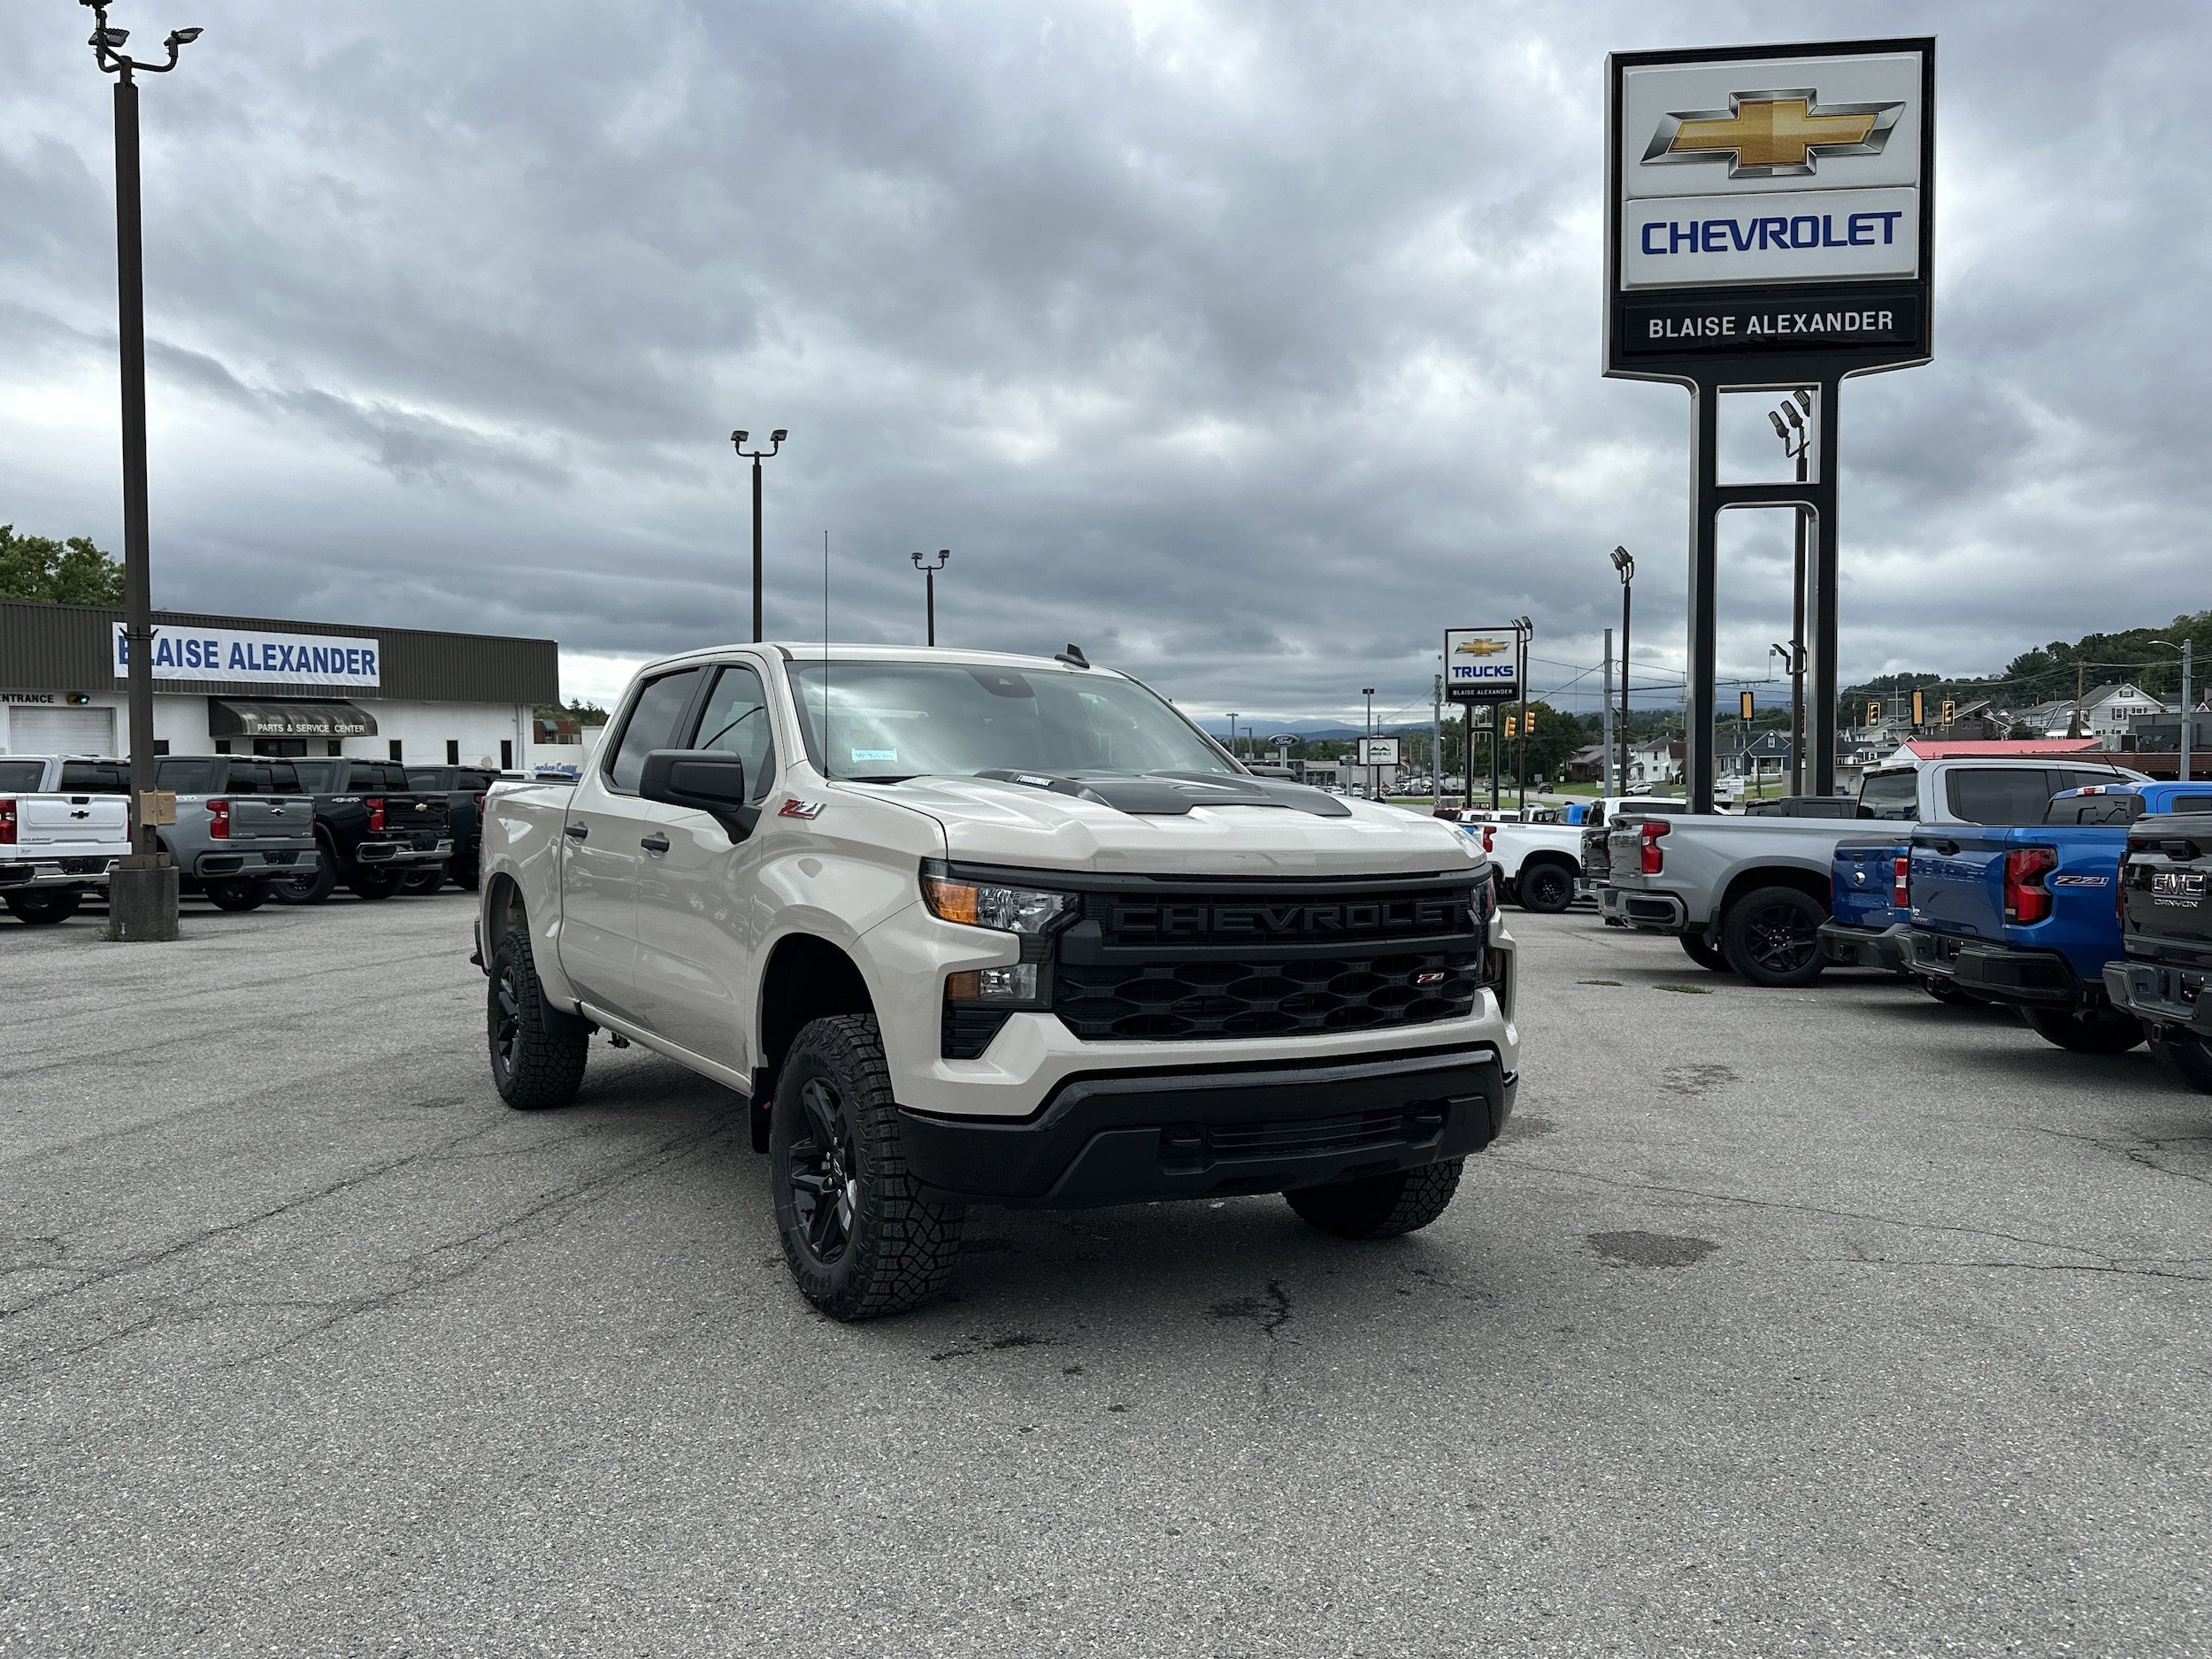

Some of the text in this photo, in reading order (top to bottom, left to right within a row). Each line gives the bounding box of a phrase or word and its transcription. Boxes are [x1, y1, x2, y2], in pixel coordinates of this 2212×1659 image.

[1641, 211, 1902, 255] CHEVROLET
[1648, 310, 1893, 339] BLAISE ALEXANDER
[228, 641, 377, 675] ALEXANDER
[1452, 665, 1514, 678] TRUCKS
[0, 694, 54, 703] NTRANCE
[257, 723, 365, 733] PARTS & SERVICE CENTER
[778, 798, 827, 820] Z71
[2152, 873, 2203, 896] GMC
[2154, 898, 2199, 909] CANYON
[1111, 899, 1470, 932] CHEVROLET
